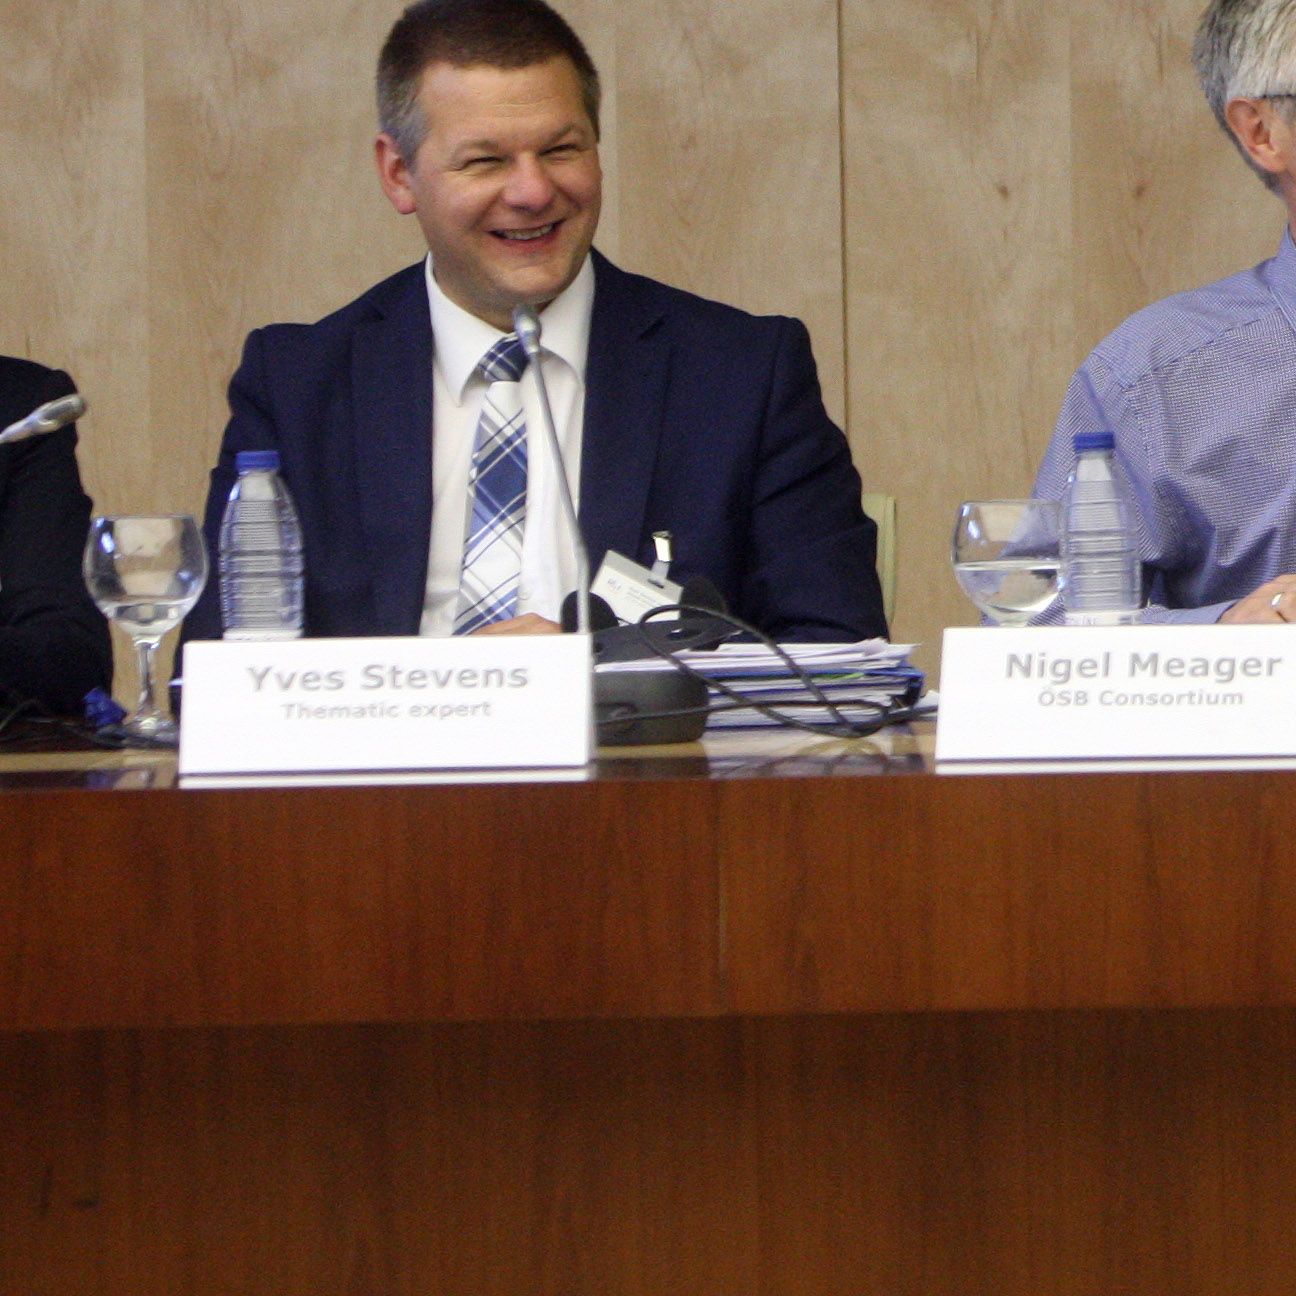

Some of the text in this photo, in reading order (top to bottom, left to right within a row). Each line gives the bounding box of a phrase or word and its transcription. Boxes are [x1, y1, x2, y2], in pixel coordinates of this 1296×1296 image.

[247, 663, 529, 692] Yves Stevens
[1005, 651, 1283, 686] Nigel Meager
[1099, 688, 1244, 706] Consortium
[281, 701, 492, 720] Thematic expert
